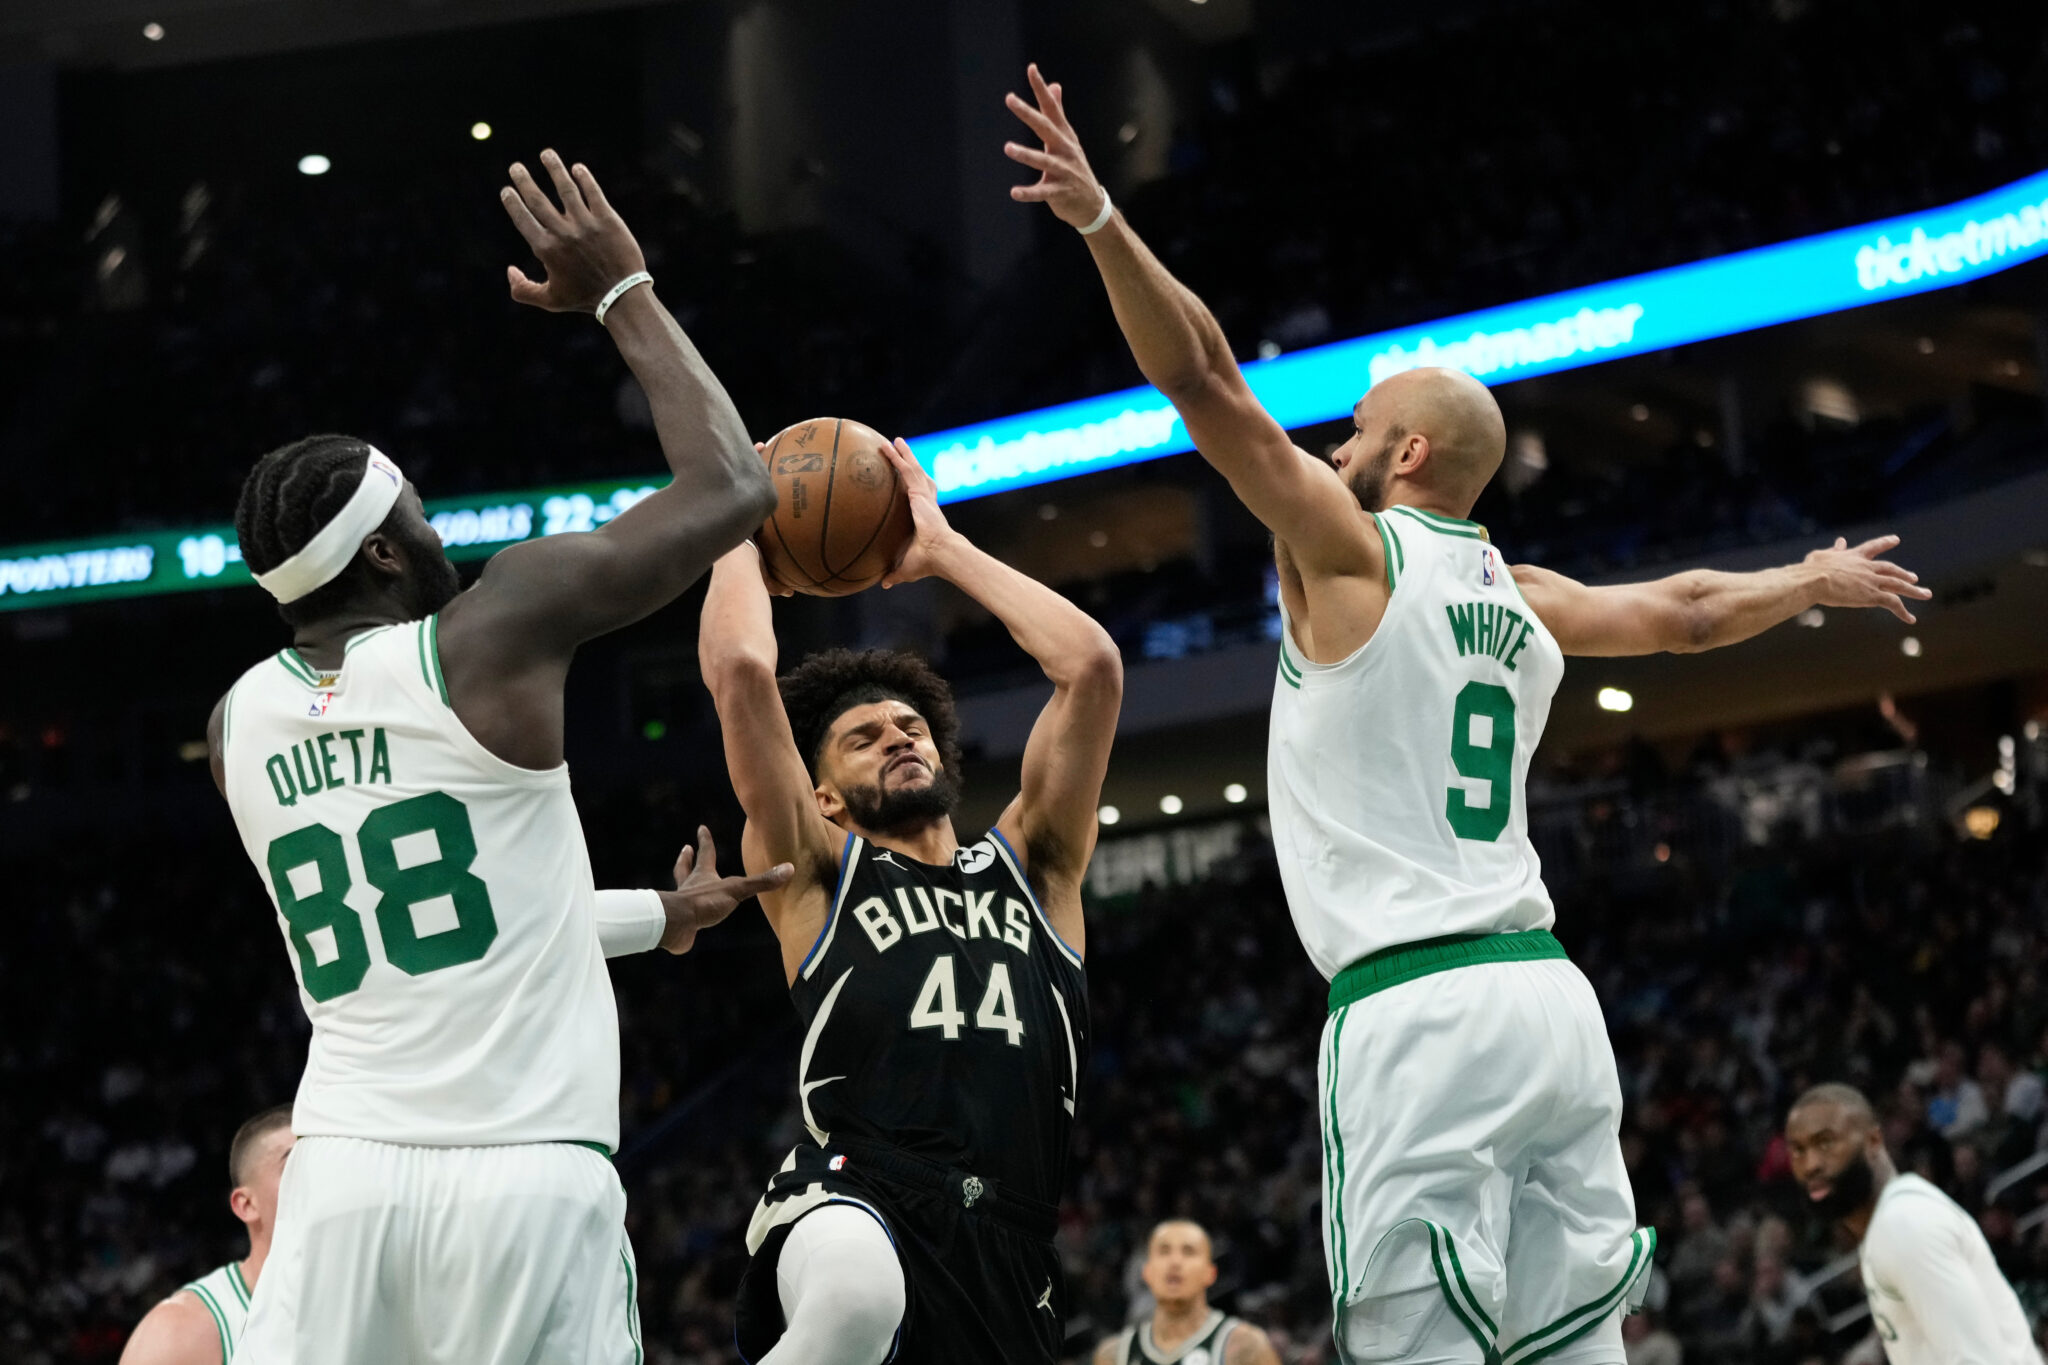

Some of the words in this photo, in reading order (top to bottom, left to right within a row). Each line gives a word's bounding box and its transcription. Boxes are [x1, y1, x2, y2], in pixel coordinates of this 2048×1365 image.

[934, 405, 1181, 491] ticketmaster
[1446, 602, 1534, 672] WHITE
[266, 727, 392, 806] QUETA
[1446, 680, 1516, 842] 9
[266, 790, 499, 1004] 88
[853, 886, 1032, 955] BUCKS
[908, 953, 1024, 1047] 44
